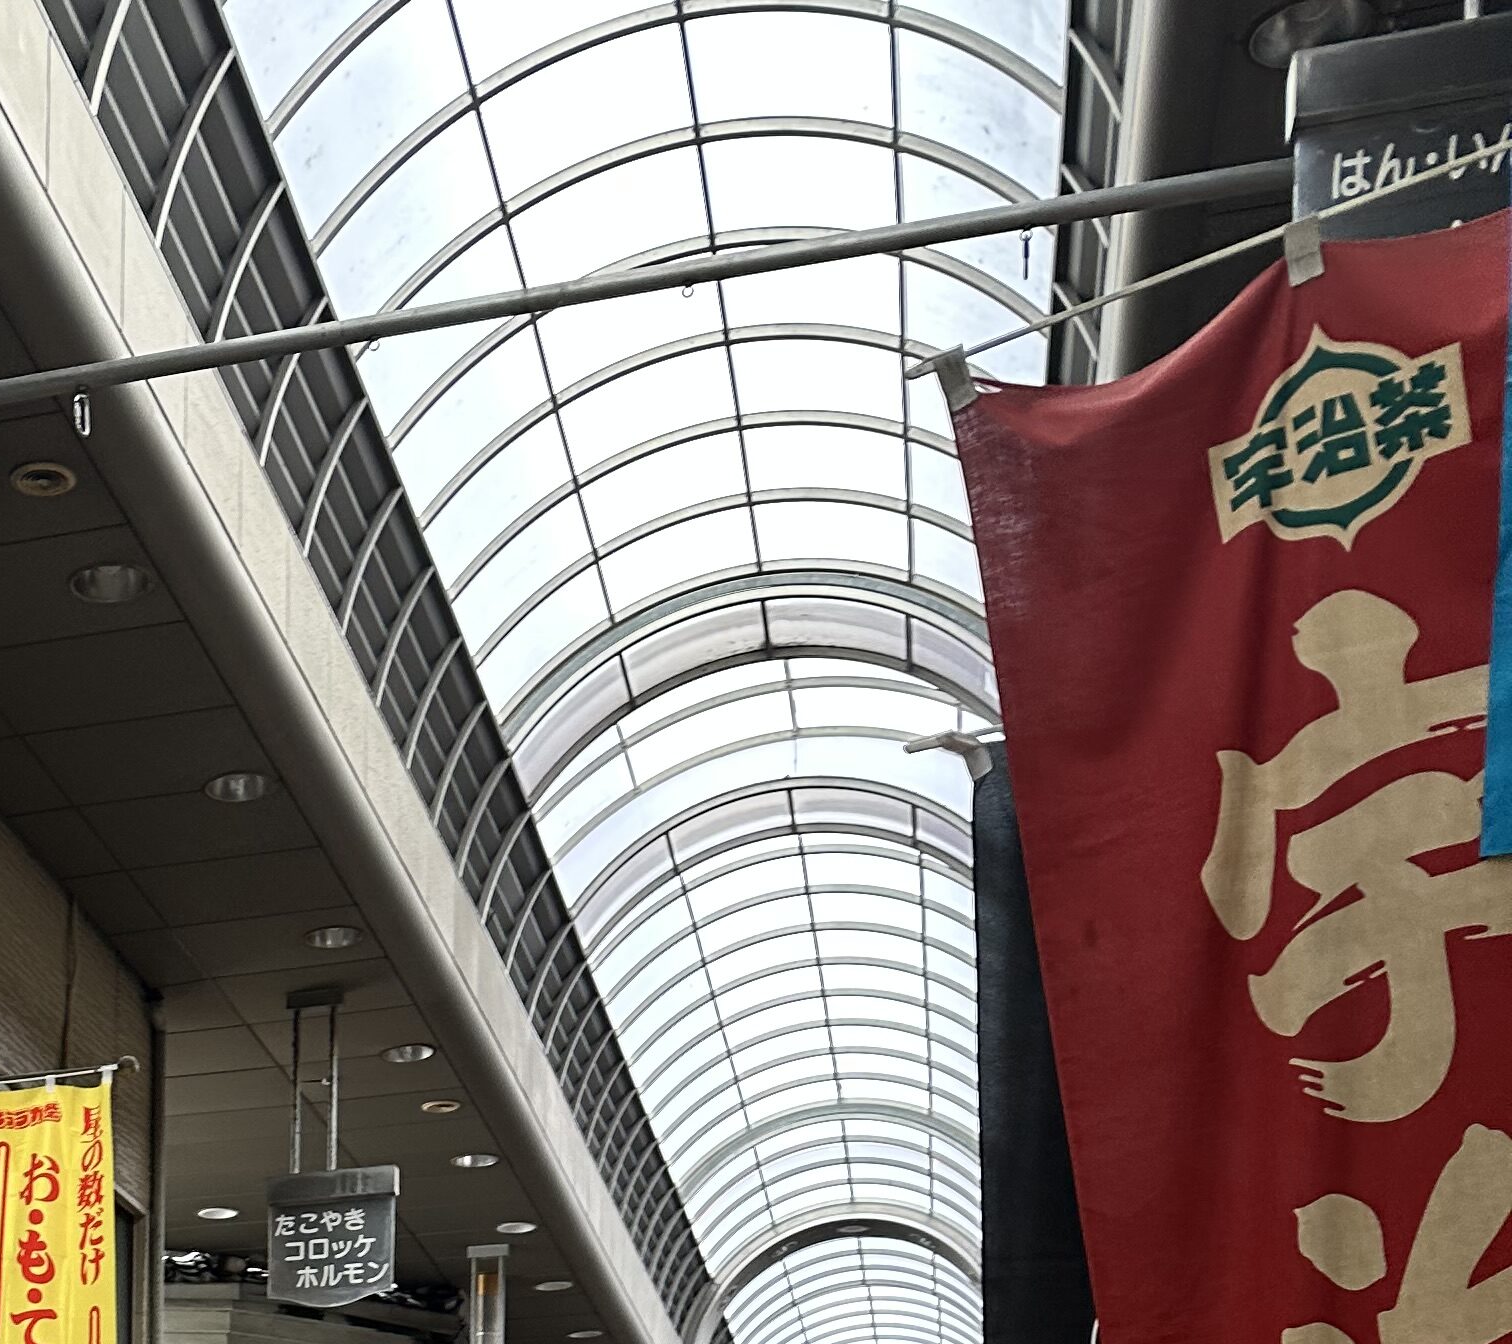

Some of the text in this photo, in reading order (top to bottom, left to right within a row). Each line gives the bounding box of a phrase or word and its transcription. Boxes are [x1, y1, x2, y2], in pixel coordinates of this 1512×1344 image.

[1331, 123, 1512, 199] はん・い
[1224, 360, 1453, 512] 宇治茶
[274, 1207, 366, 1237] たこやき
[284, 1234, 377, 1262] コロッケ
[295, 1261, 390, 1289] ホルモン
